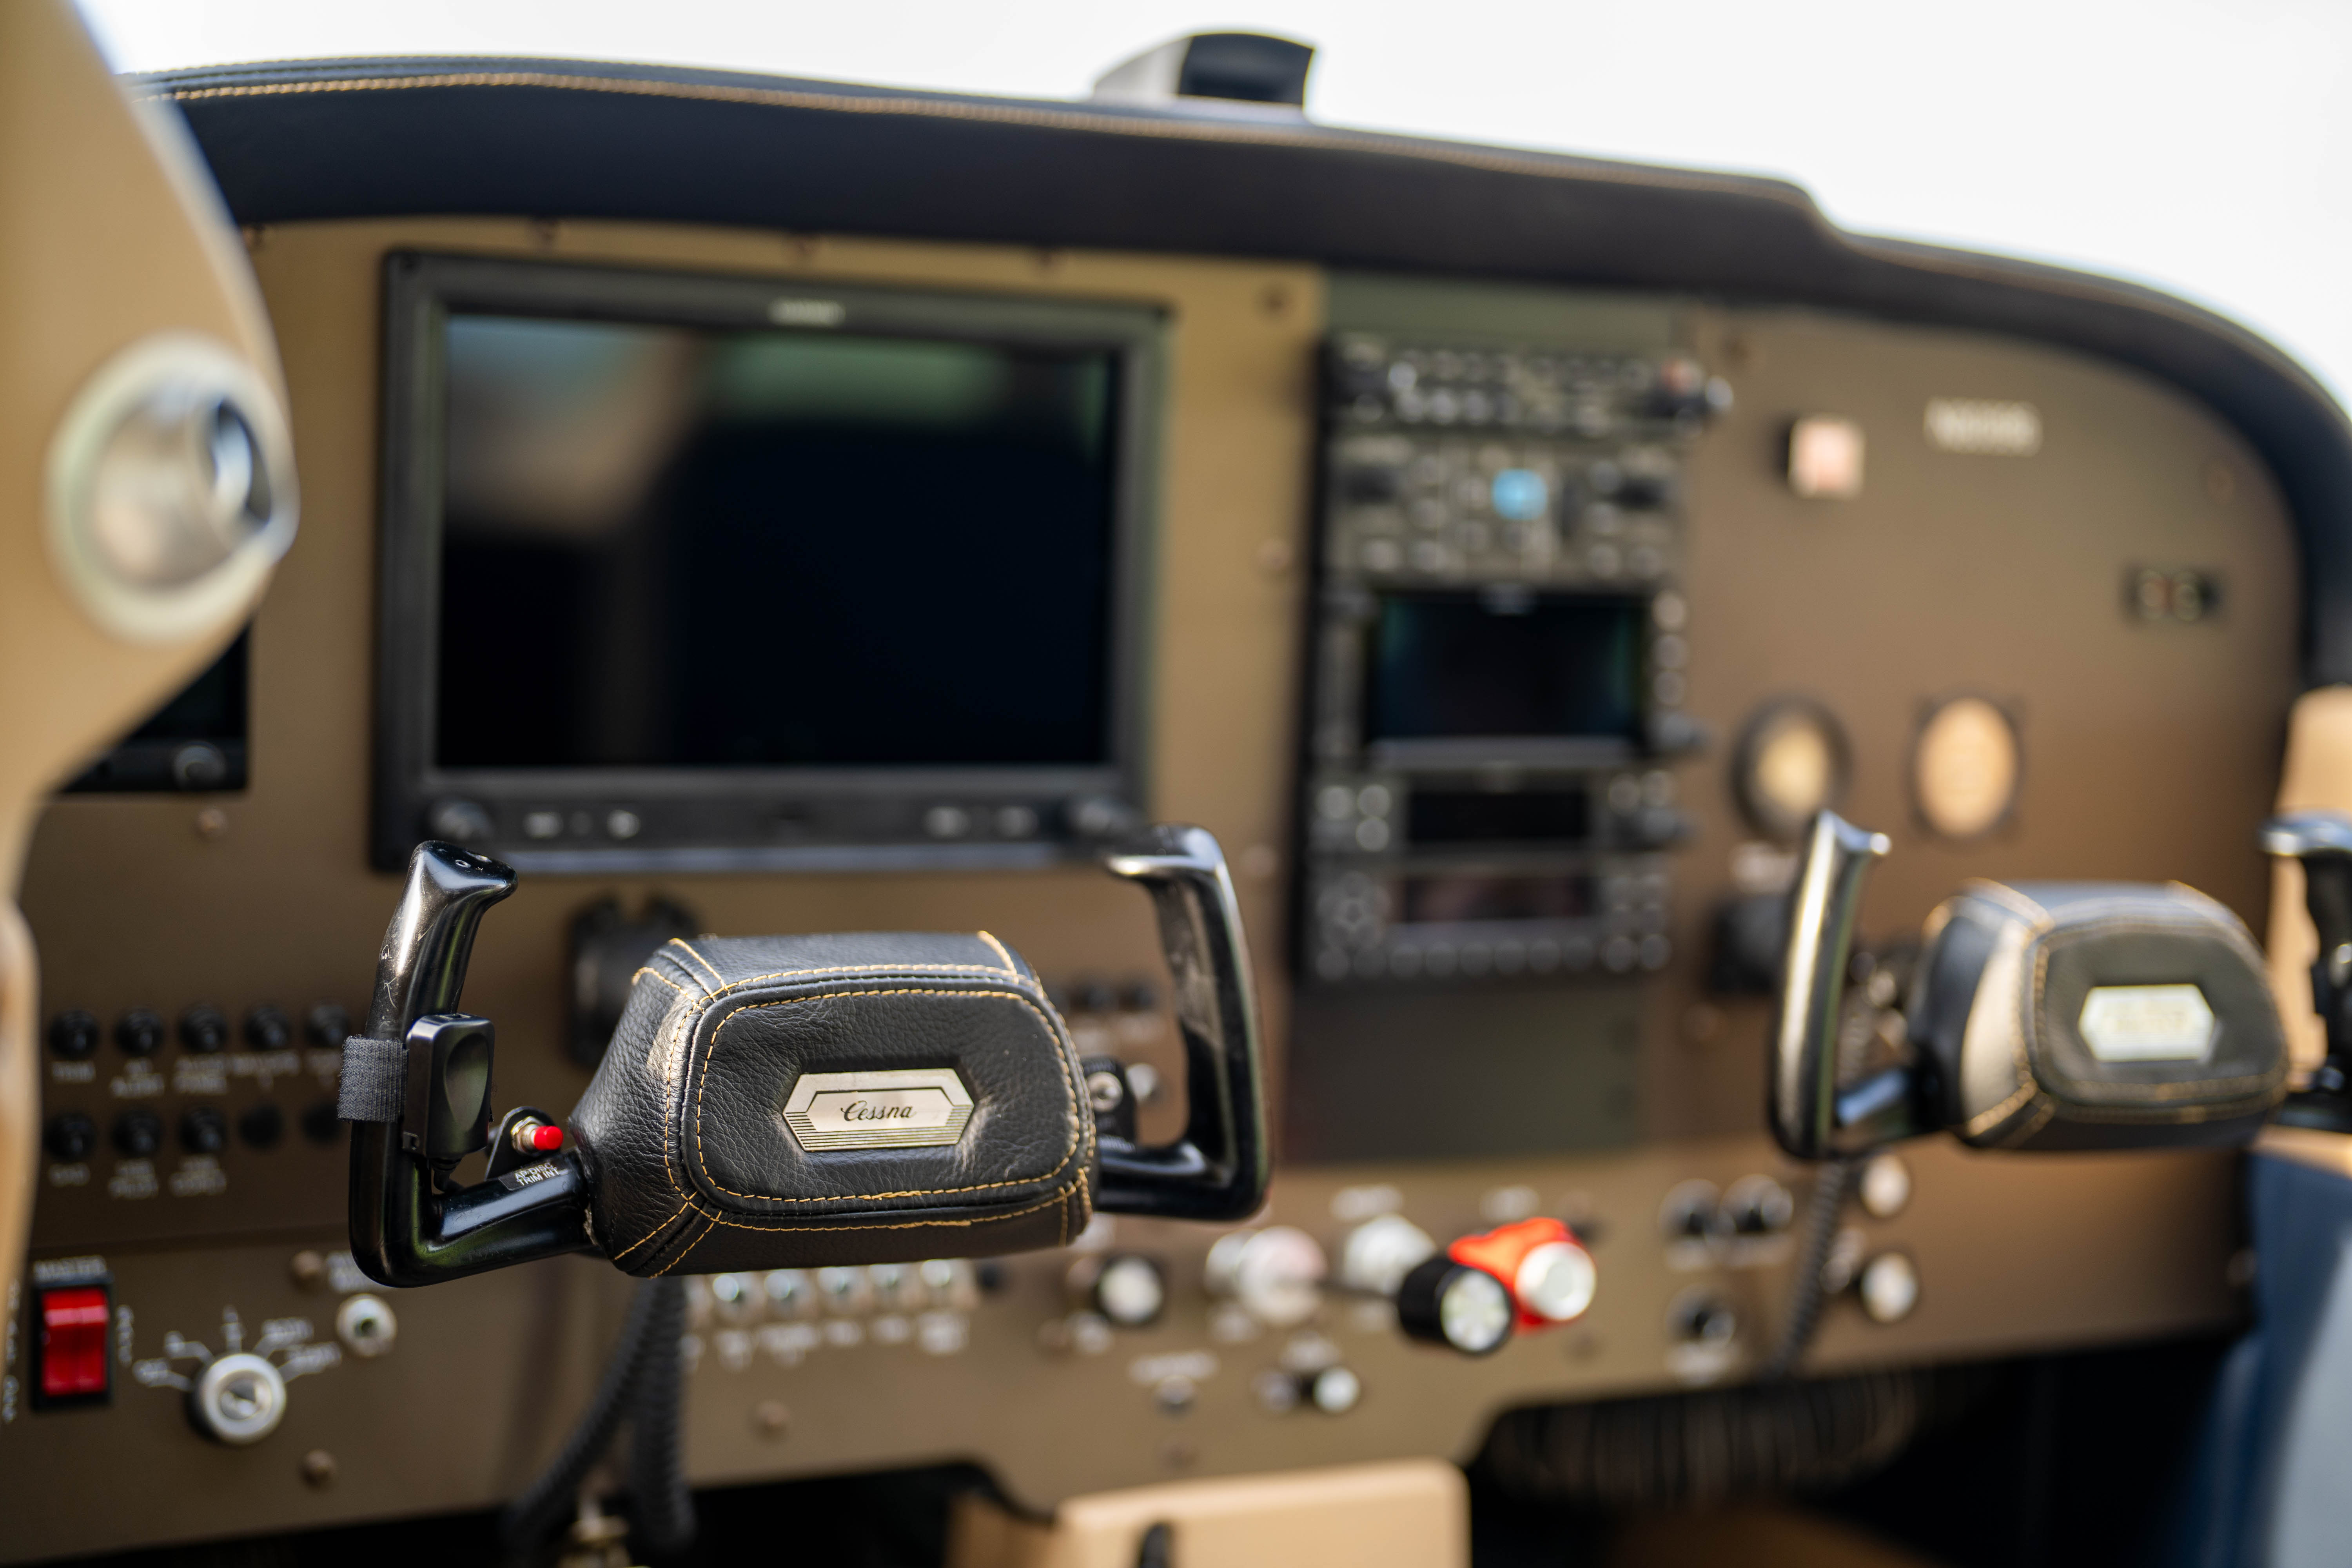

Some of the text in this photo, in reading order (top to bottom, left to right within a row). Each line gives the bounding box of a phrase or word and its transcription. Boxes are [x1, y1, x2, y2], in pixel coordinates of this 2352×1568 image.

[840, 1100, 916, 1121] Cessna
[514, 1162, 553, 1181] AP DISC
[517, 1167, 559, 1186] TRIM INT
